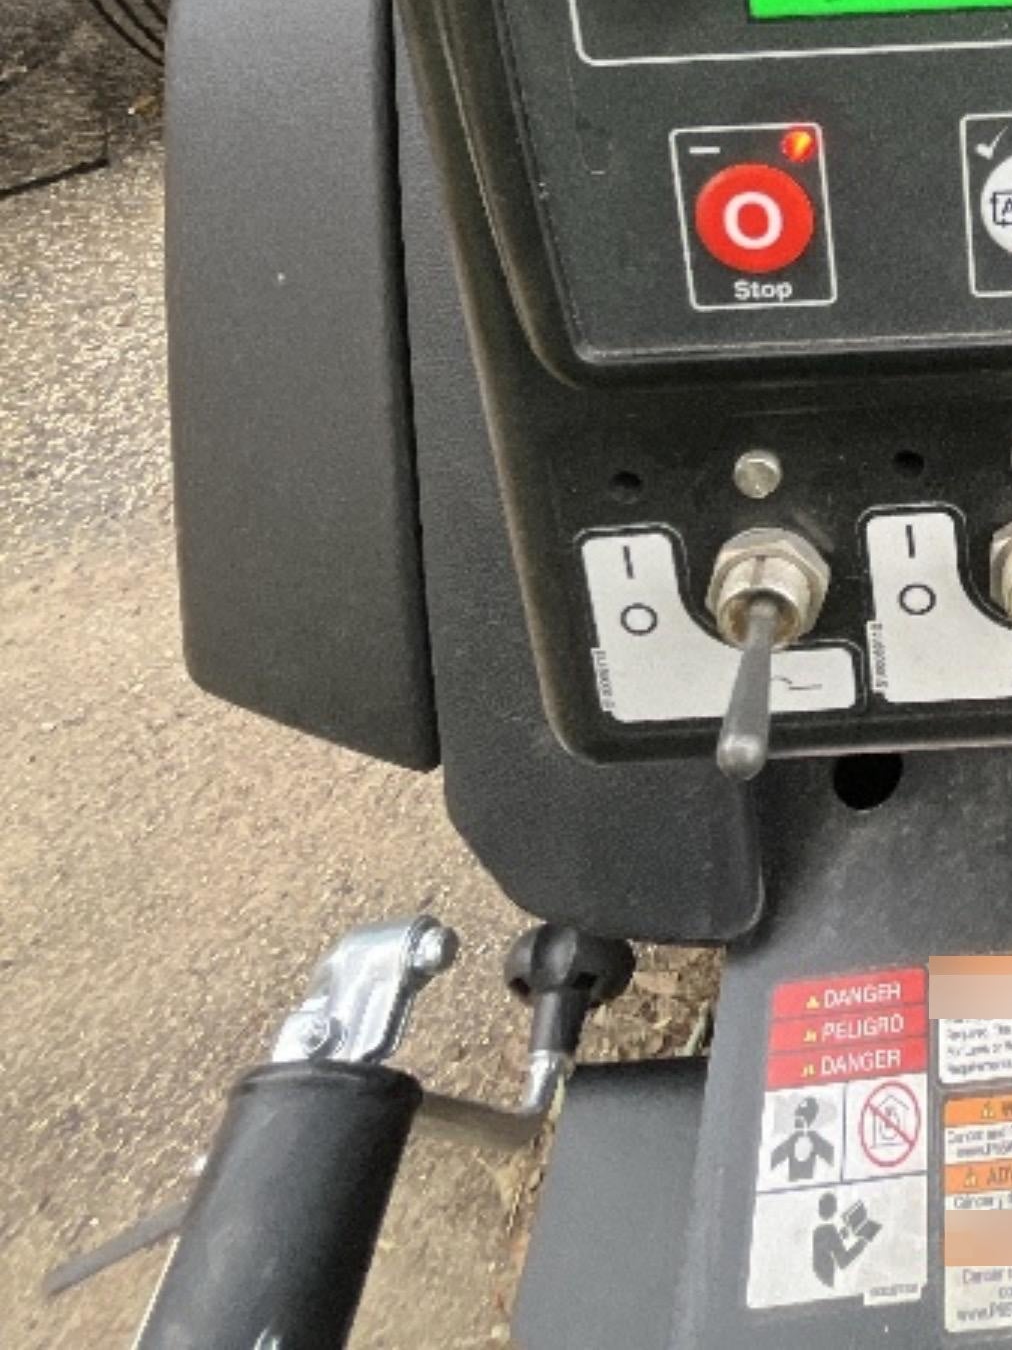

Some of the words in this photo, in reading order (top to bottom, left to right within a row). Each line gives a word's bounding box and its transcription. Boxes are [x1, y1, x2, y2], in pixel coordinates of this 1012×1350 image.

[732, 277, 794, 303] Stop
[823, 980, 901, 1009] DANGER
[821, 1013, 904, 1043] PELIGRO
[821, 1049, 901, 1075] DANGER
